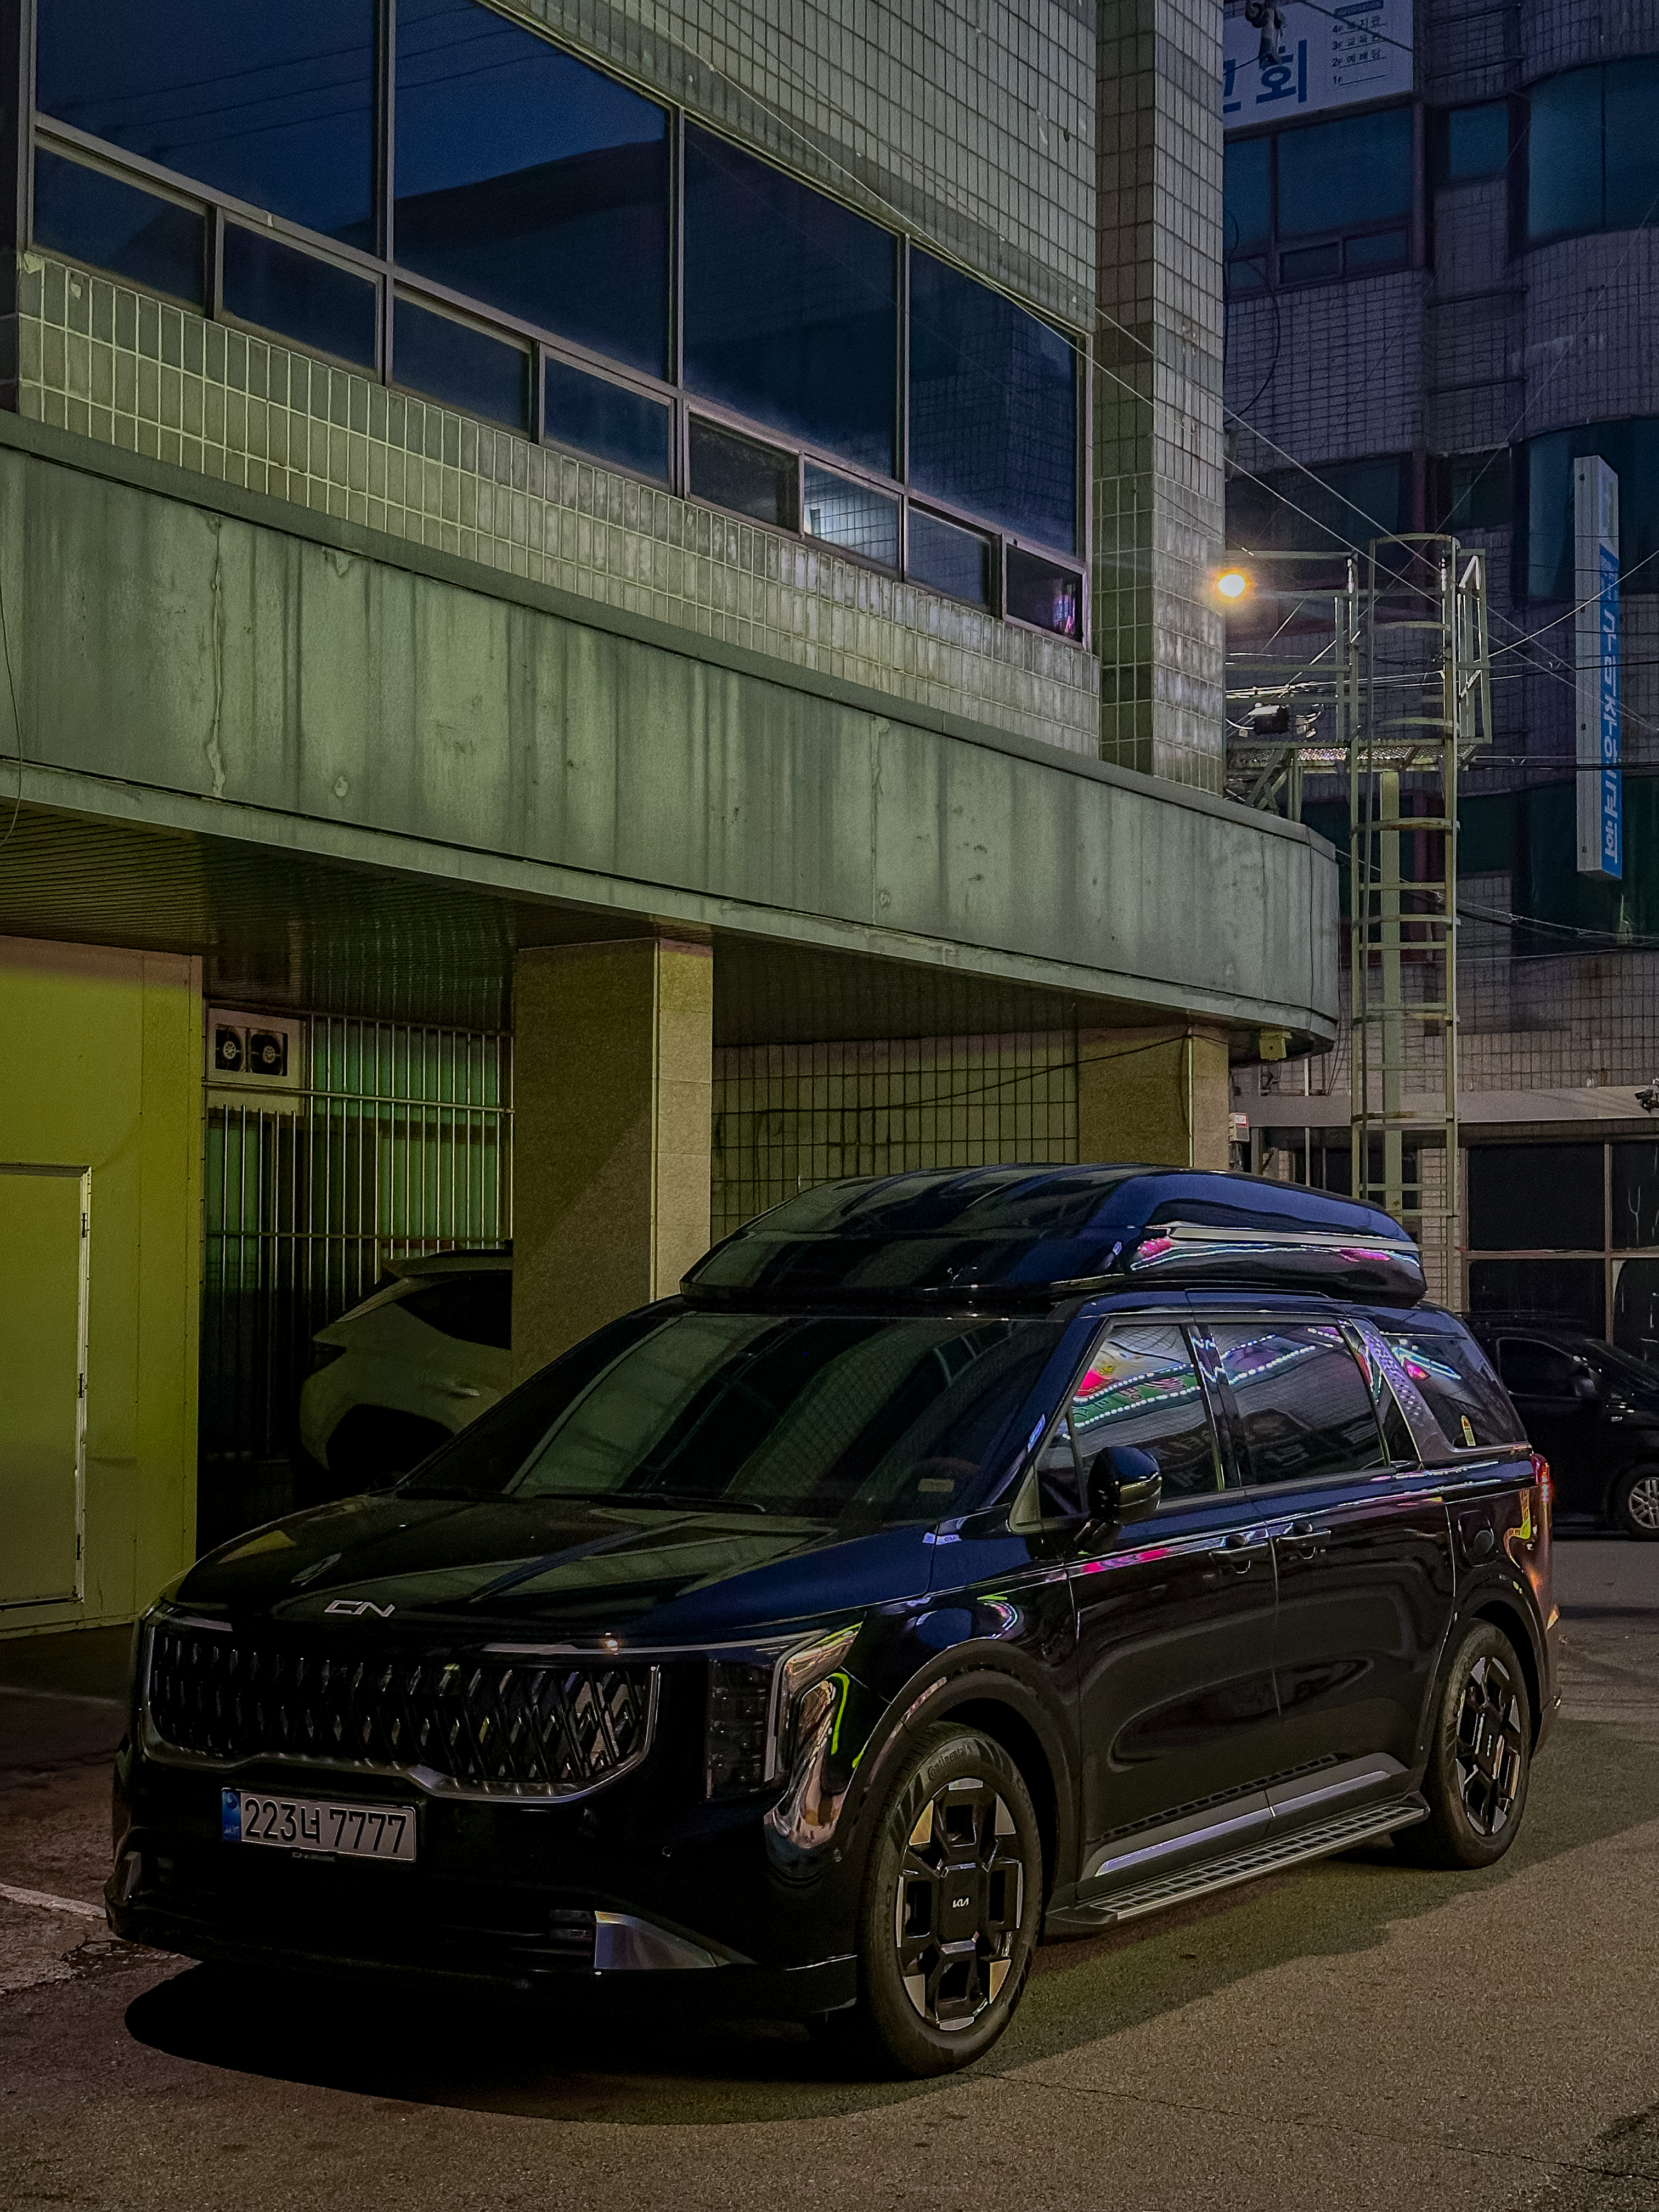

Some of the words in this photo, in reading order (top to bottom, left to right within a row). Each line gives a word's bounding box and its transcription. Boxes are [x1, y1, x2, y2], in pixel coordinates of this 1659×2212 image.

[1332, 24, 1343, 33] 4F
[1332, 40, 1343, 50] 3F
[1332, 58, 1343, 67] 2F
[1333, 75, 1343, 84] 1F
[245, 1798, 321, 1844] 223너
[330, 1807, 407, 1853] 7777
